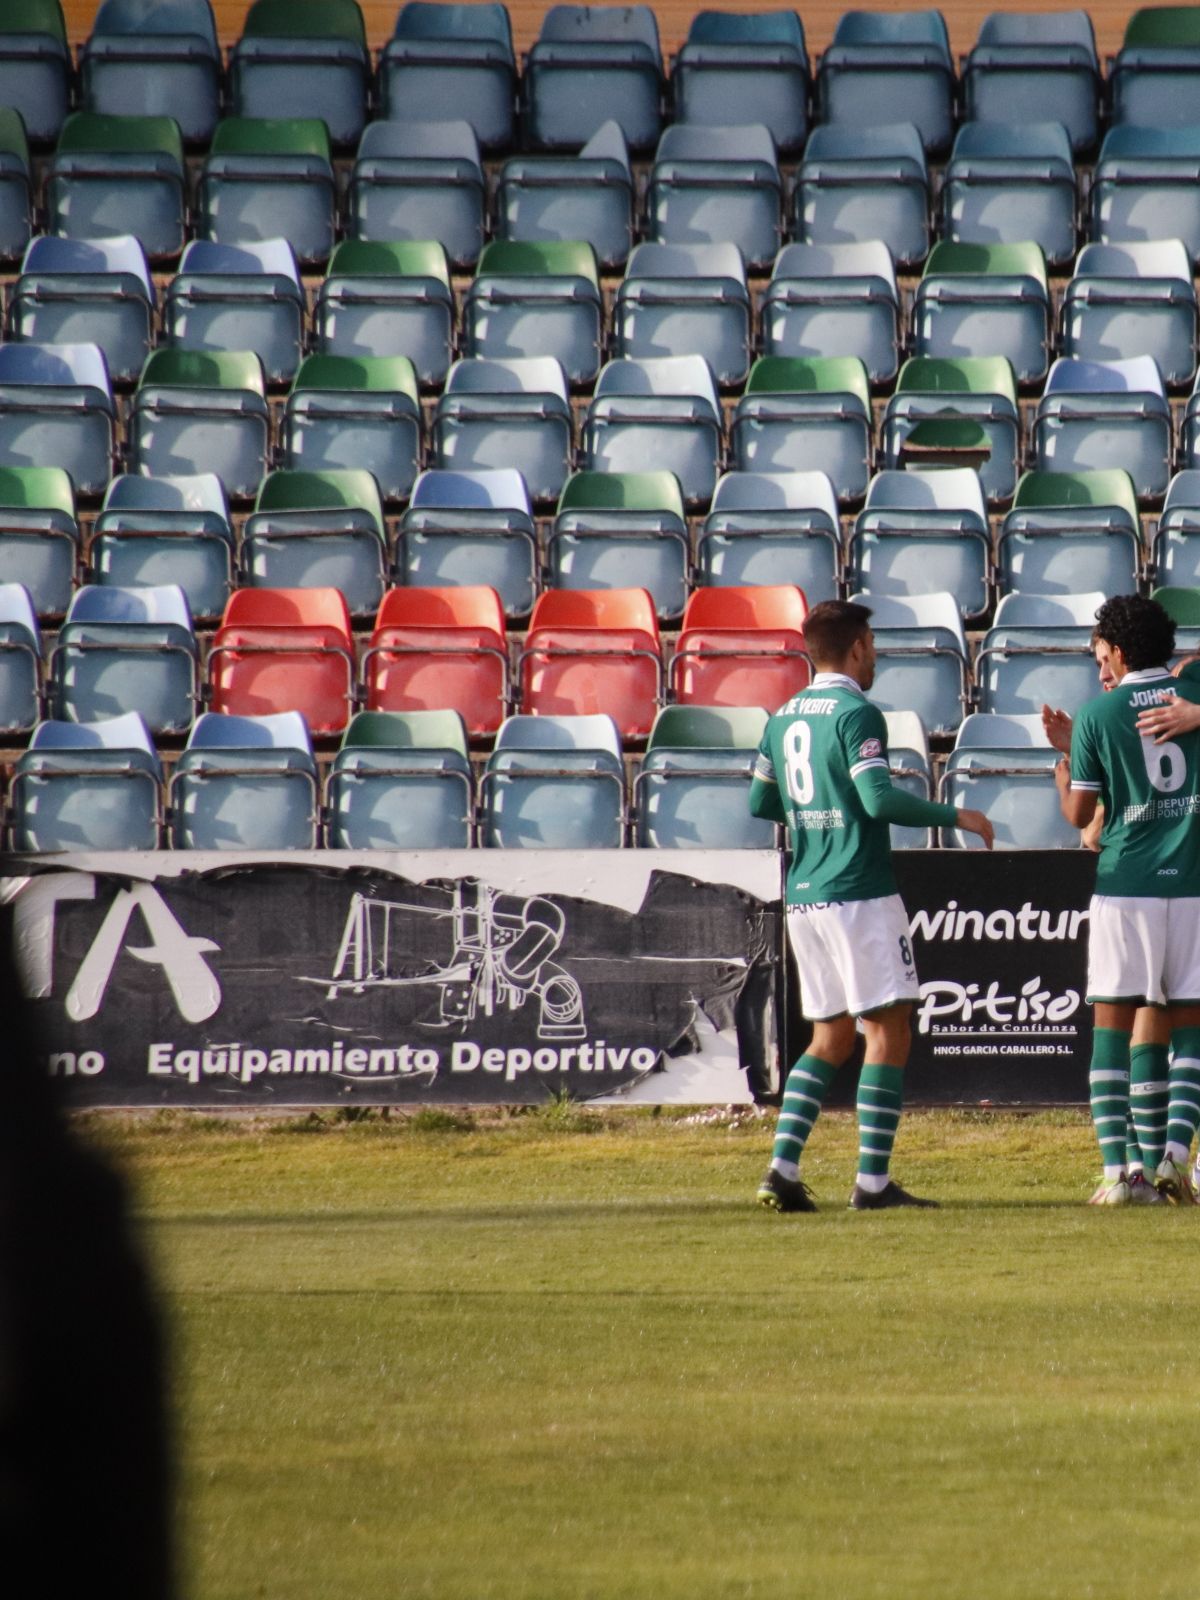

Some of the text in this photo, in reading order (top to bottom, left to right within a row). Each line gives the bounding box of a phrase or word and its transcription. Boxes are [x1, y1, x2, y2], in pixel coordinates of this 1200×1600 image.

[783, 720, 815, 805] 8
[1137, 716, 1187, 793] 6
[898, 934, 913, 967] 8
[932, 1023, 1077, 1033] Sabor de Confianza
[49, 1042, 659, 1083] no Equipamiento Deportivo
[934, 1045, 1074, 1055] HNOS GARCIA CABALLERO S.L.
